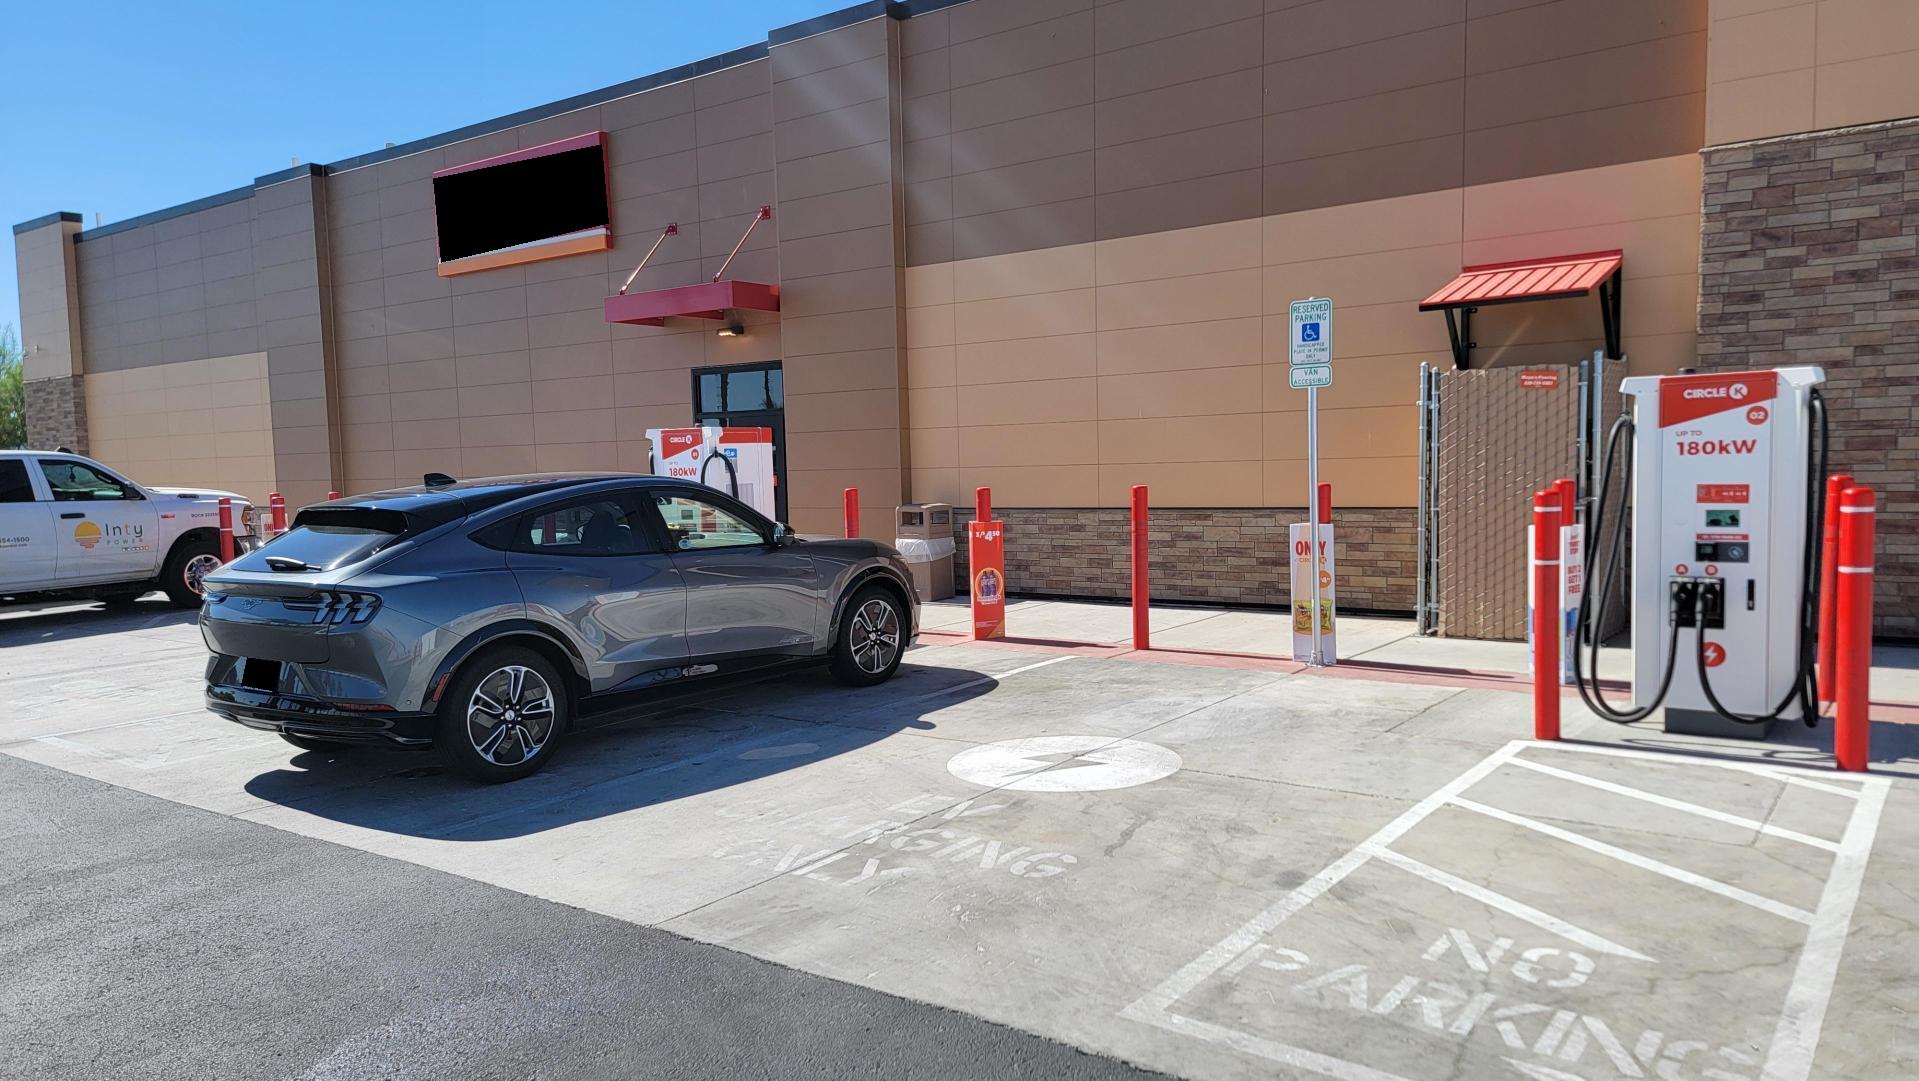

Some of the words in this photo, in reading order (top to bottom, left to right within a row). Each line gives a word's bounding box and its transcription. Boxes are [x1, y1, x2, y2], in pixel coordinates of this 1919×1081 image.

[1293, 303, 1328, 313] RESERVED
[1295, 313, 1326, 322] PARKING
[1293, 377, 1329, 385] ACCESSIBLE
[1683, 387, 1728, 399] CIRCLE
[1729, 384, 1747, 399] K
[1676, 439, 1757, 456] 180kW
[669, 467, 697, 477] 180kW
[105, 523, 143, 538] Inty
[1295, 540, 1327, 556] ONY
[1420, 926, 1596, 989] NO
[1221, 942, 1756, 1081] PARKING
